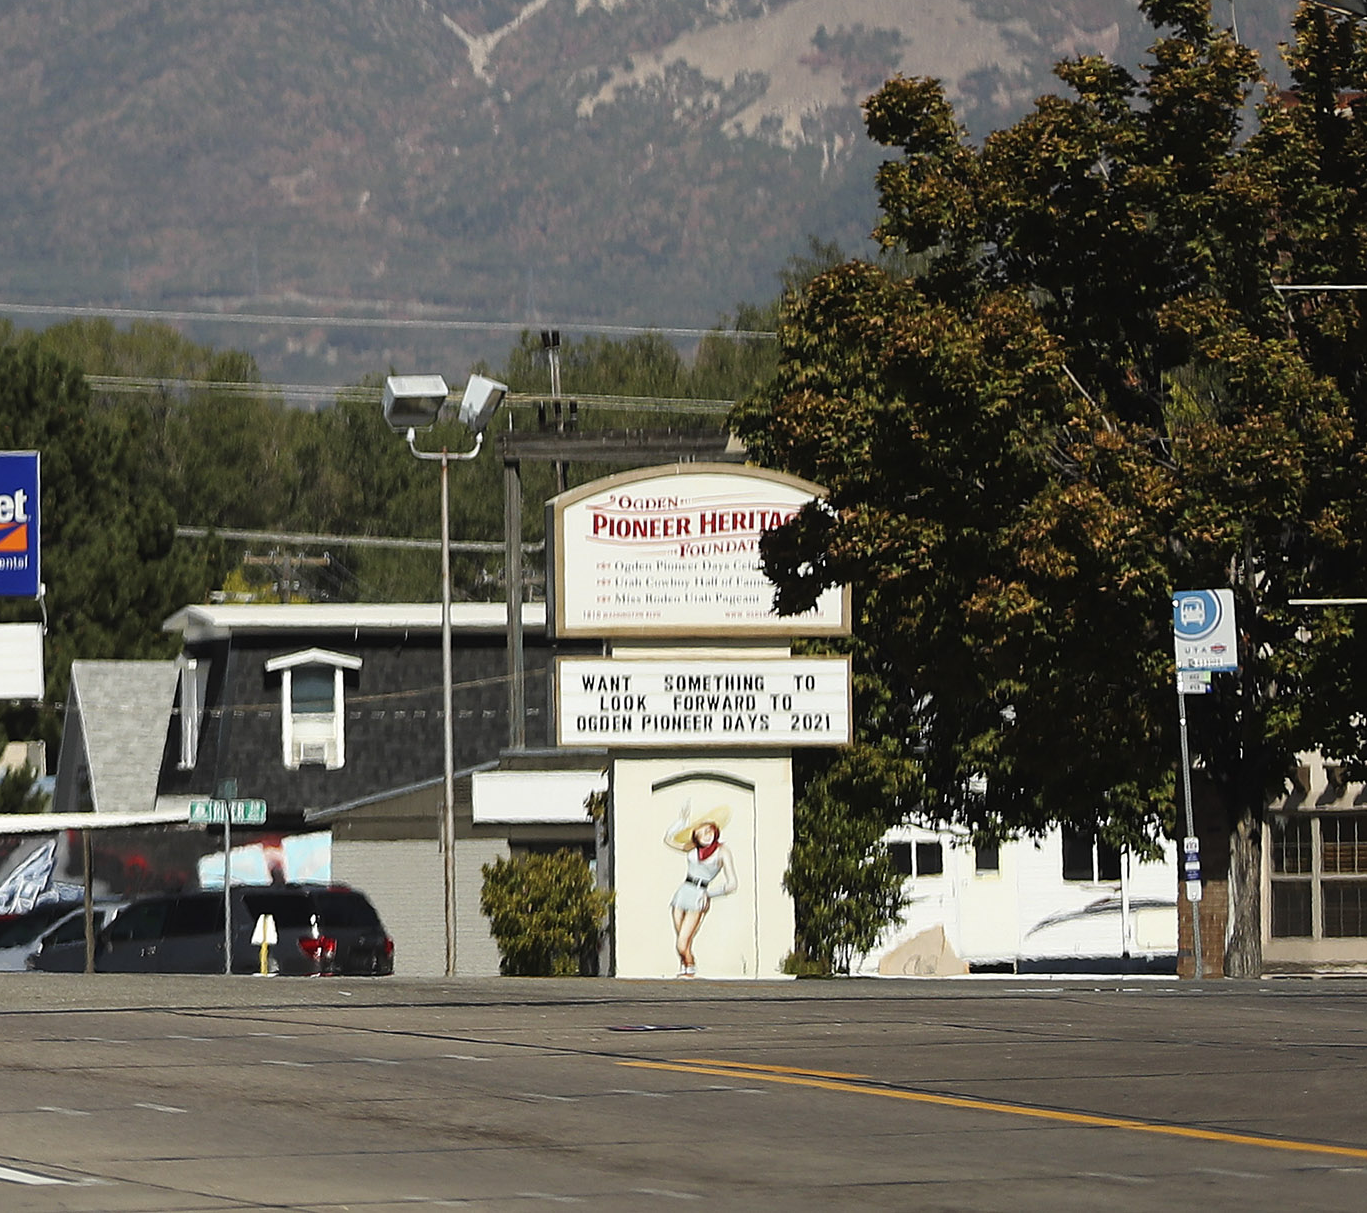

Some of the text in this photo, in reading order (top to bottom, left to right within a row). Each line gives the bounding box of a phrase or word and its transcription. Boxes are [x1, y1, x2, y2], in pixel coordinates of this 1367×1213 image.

[618, 495, 678, 511] OGDEN
[592, 509, 799, 538] PIONEER HERITA
[680, 538, 759, 558] FOUNDAT
[614, 559, 652, 573] Ogden
[656, 559, 698, 571] Pioneer
[702, 560, 729, 574] Days
[615, 576, 642, 587] Utah
[694, 576, 718, 587] Hall
[615, 593, 760, 606] Miss Rodeo Utah Pageant
[581, 674, 816, 692] WANT SOMETHING TO
[599, 693, 793, 712] LOOK FORWARD TO
[576, 714, 832, 732] OGDEN PIONEER DAYS 2021
